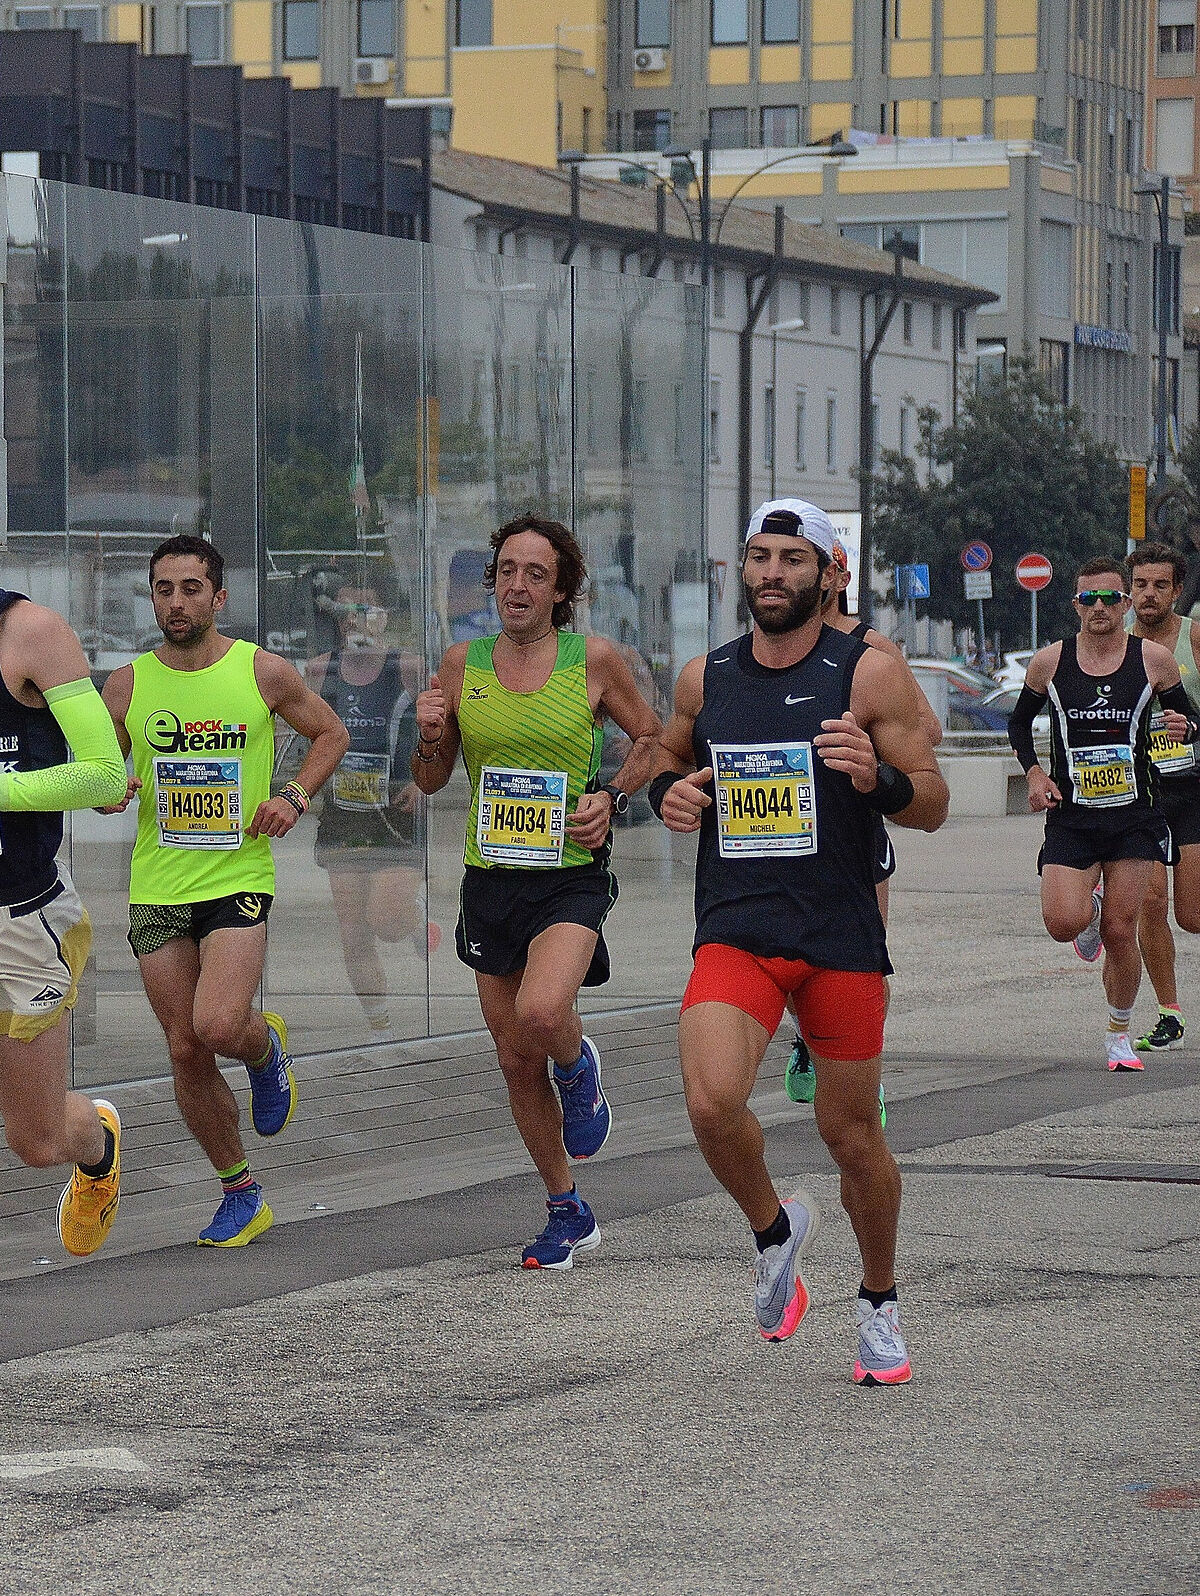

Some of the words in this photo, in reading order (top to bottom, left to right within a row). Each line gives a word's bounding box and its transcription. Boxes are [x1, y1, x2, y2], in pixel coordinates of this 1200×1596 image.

[1068, 709, 1131, 720] Grottini
[184, 720, 223, 734] ROCK
[745, 754, 767, 762] HOKA
[1084, 768, 1122, 789] H4382
[172, 793, 224, 818] H4033
[731, 787, 793, 819] H4044
[494, 804, 546, 833] H4034
